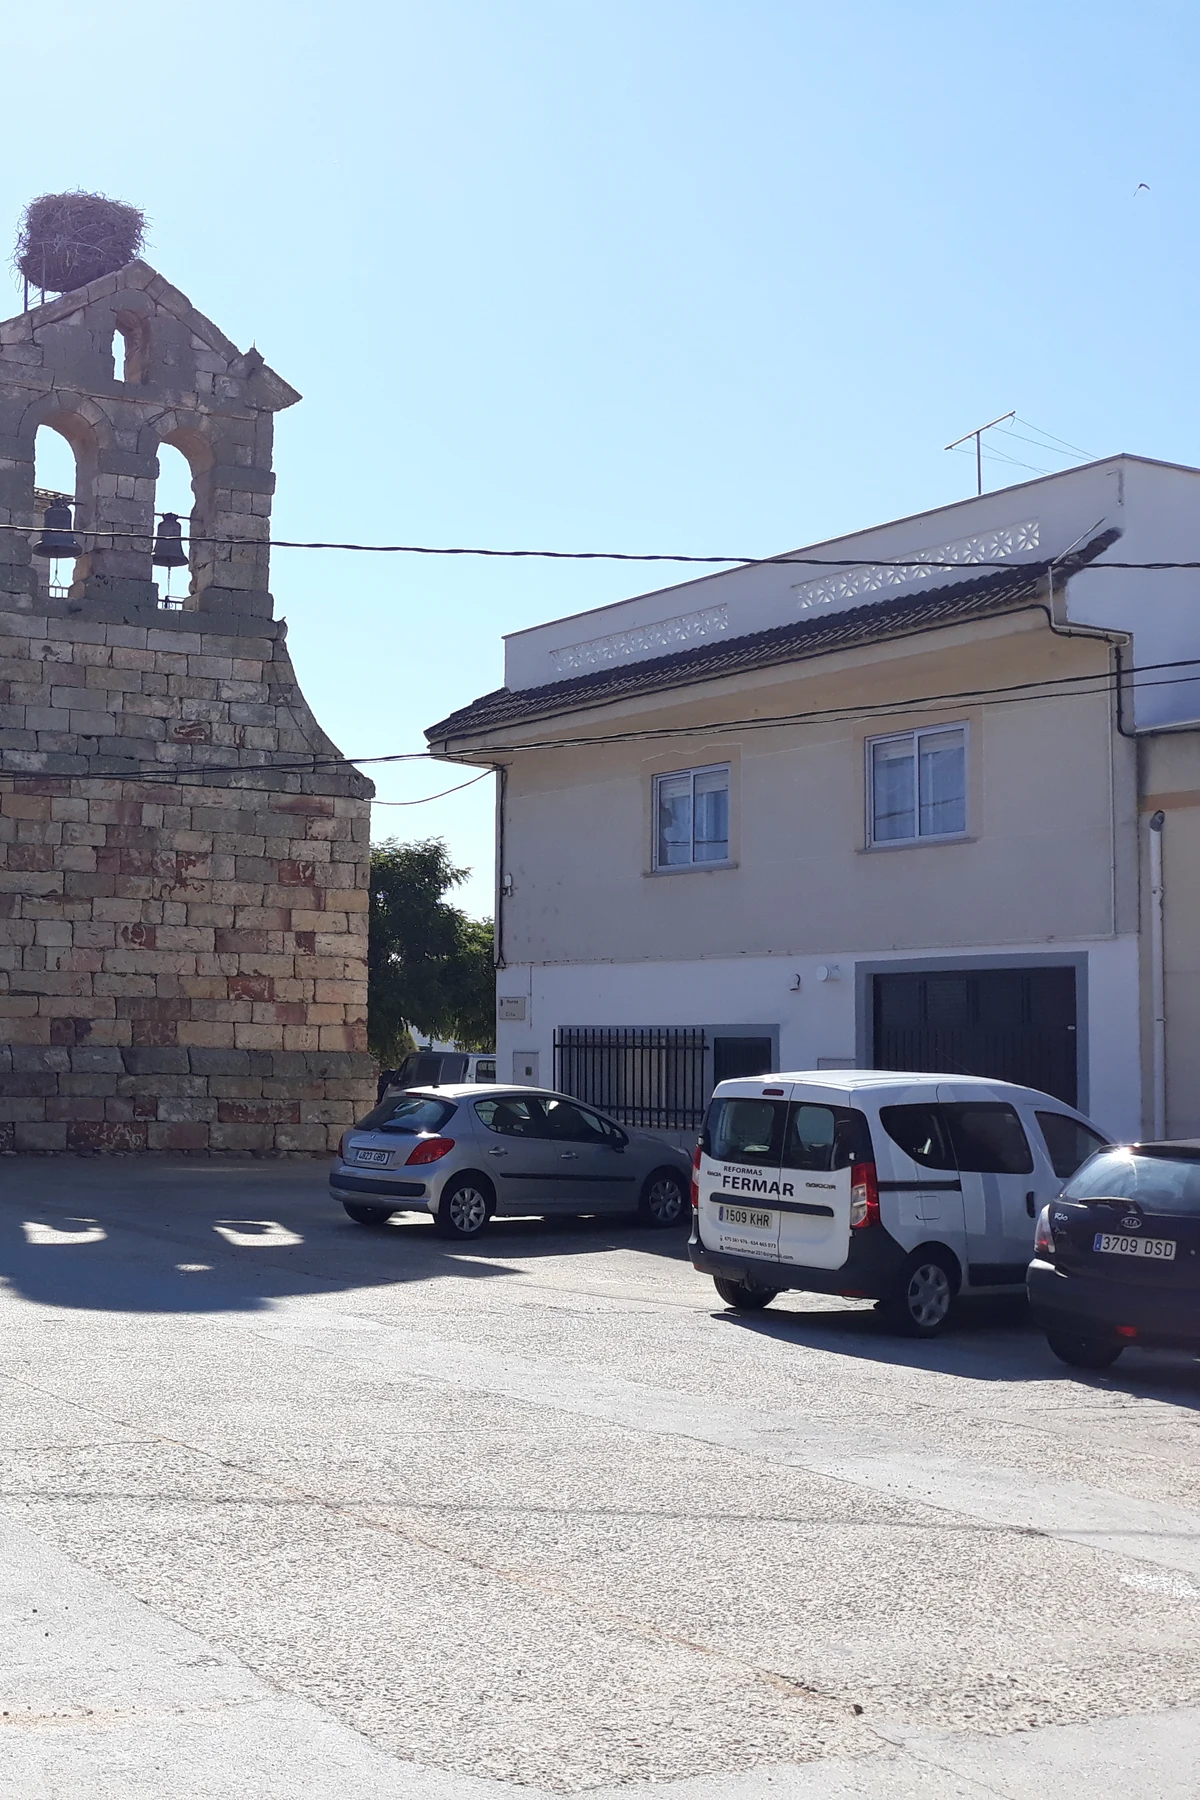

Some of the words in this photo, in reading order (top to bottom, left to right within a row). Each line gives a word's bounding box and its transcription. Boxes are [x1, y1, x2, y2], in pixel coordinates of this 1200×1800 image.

[723, 1165, 763, 1176] REFORMAS
[722, 1175, 795, 1197] FERMAR
[726, 1209, 747, 1224] 1509
[749, 1212, 770, 1227] KHR
[1102, 1236, 1138, 1253] 3709
[1144, 1240, 1174, 1257] DSD
